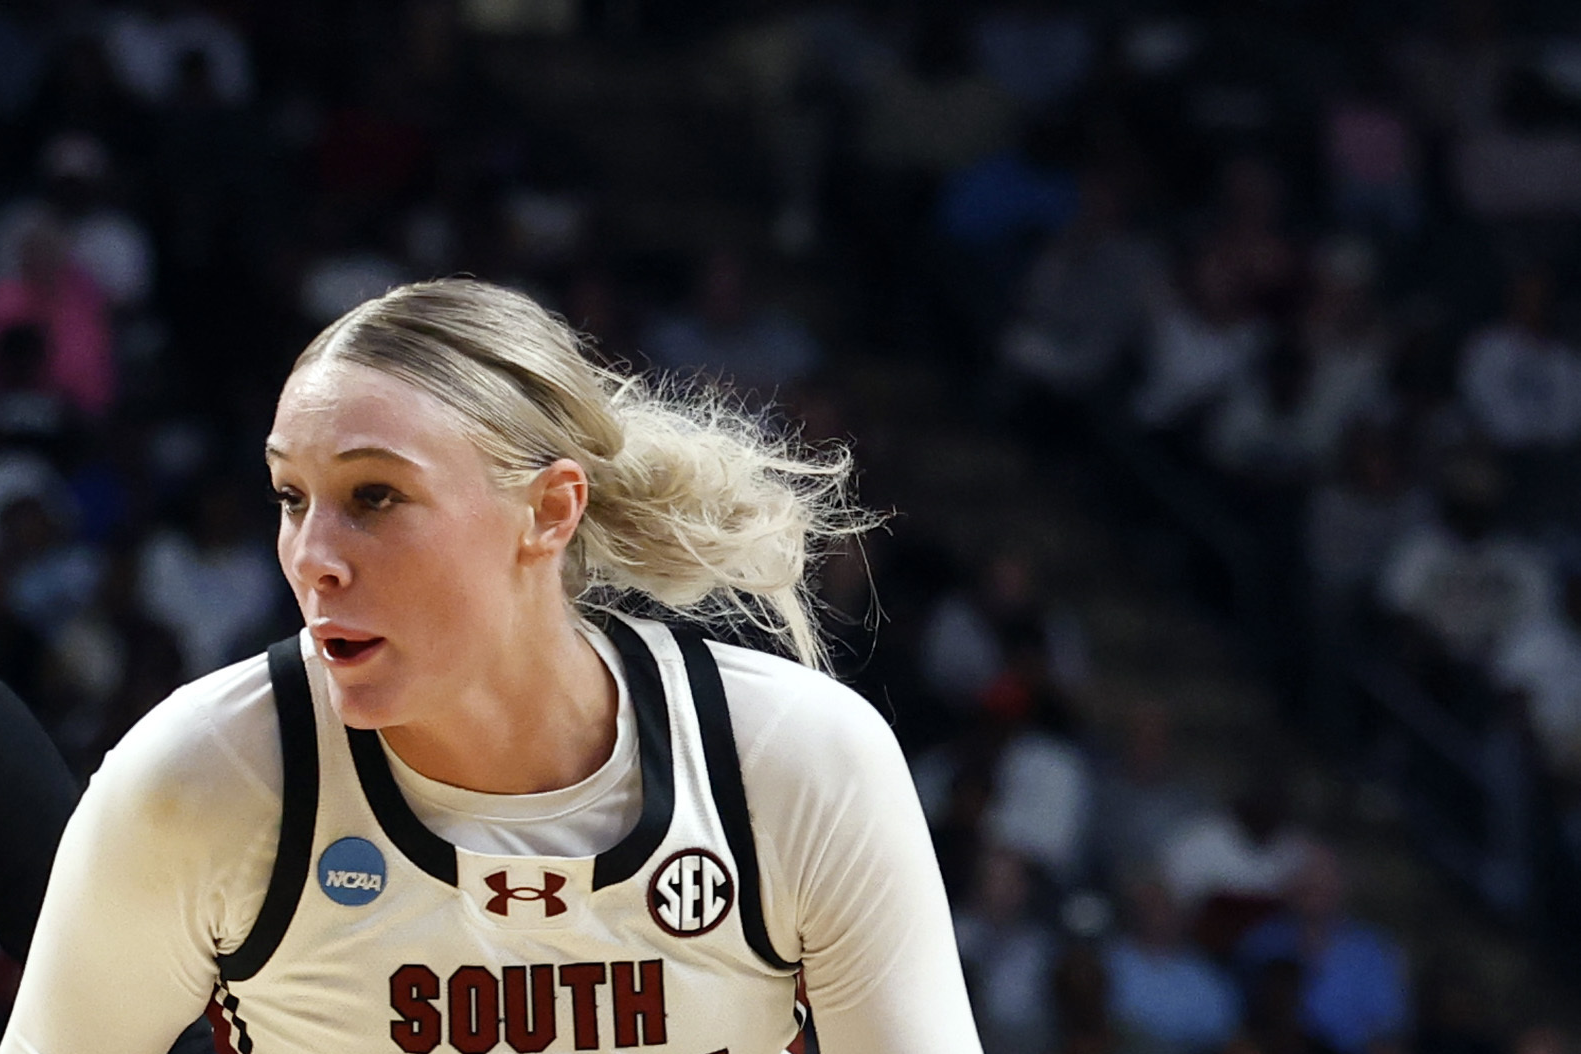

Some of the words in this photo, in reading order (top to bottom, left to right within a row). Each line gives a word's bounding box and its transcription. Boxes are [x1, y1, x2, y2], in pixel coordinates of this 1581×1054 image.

[325, 870, 382, 892] NCAA
[655, 854, 727, 931] SEC
[389, 958, 668, 1054] SOUTH
